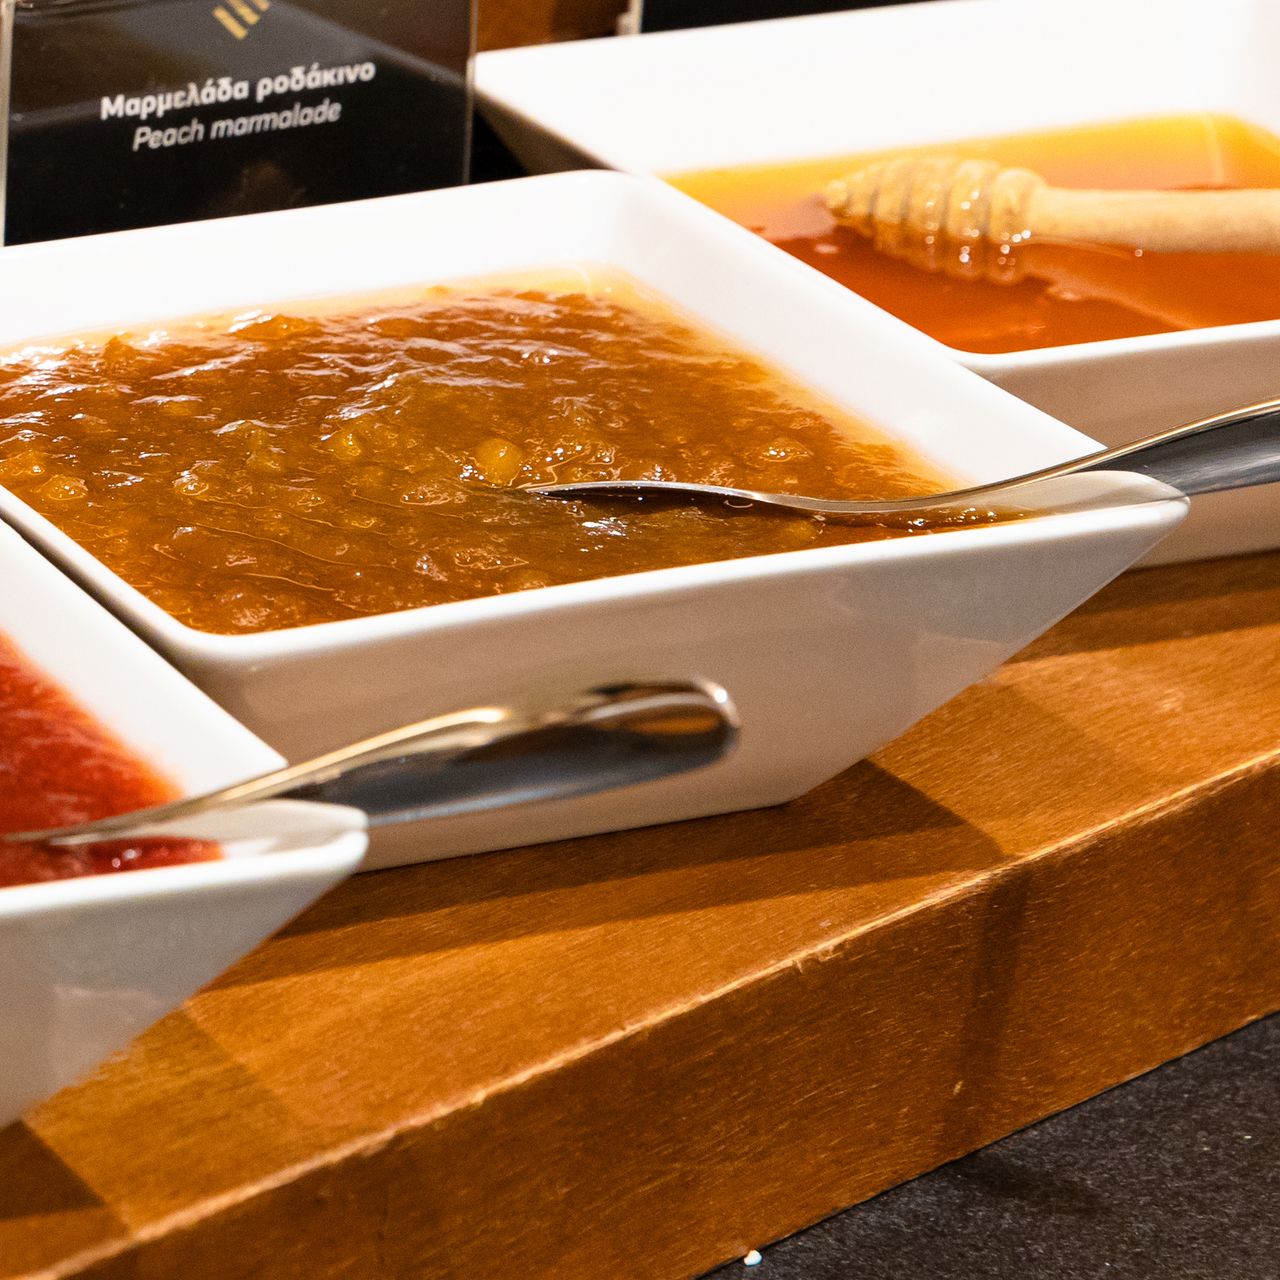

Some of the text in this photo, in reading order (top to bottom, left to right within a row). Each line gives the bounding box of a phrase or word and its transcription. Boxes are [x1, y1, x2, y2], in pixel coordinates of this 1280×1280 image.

[100, 62, 376, 120] Μαρμελάδα ροδάκινο
[132, 98, 342, 151] Peach marmalade
